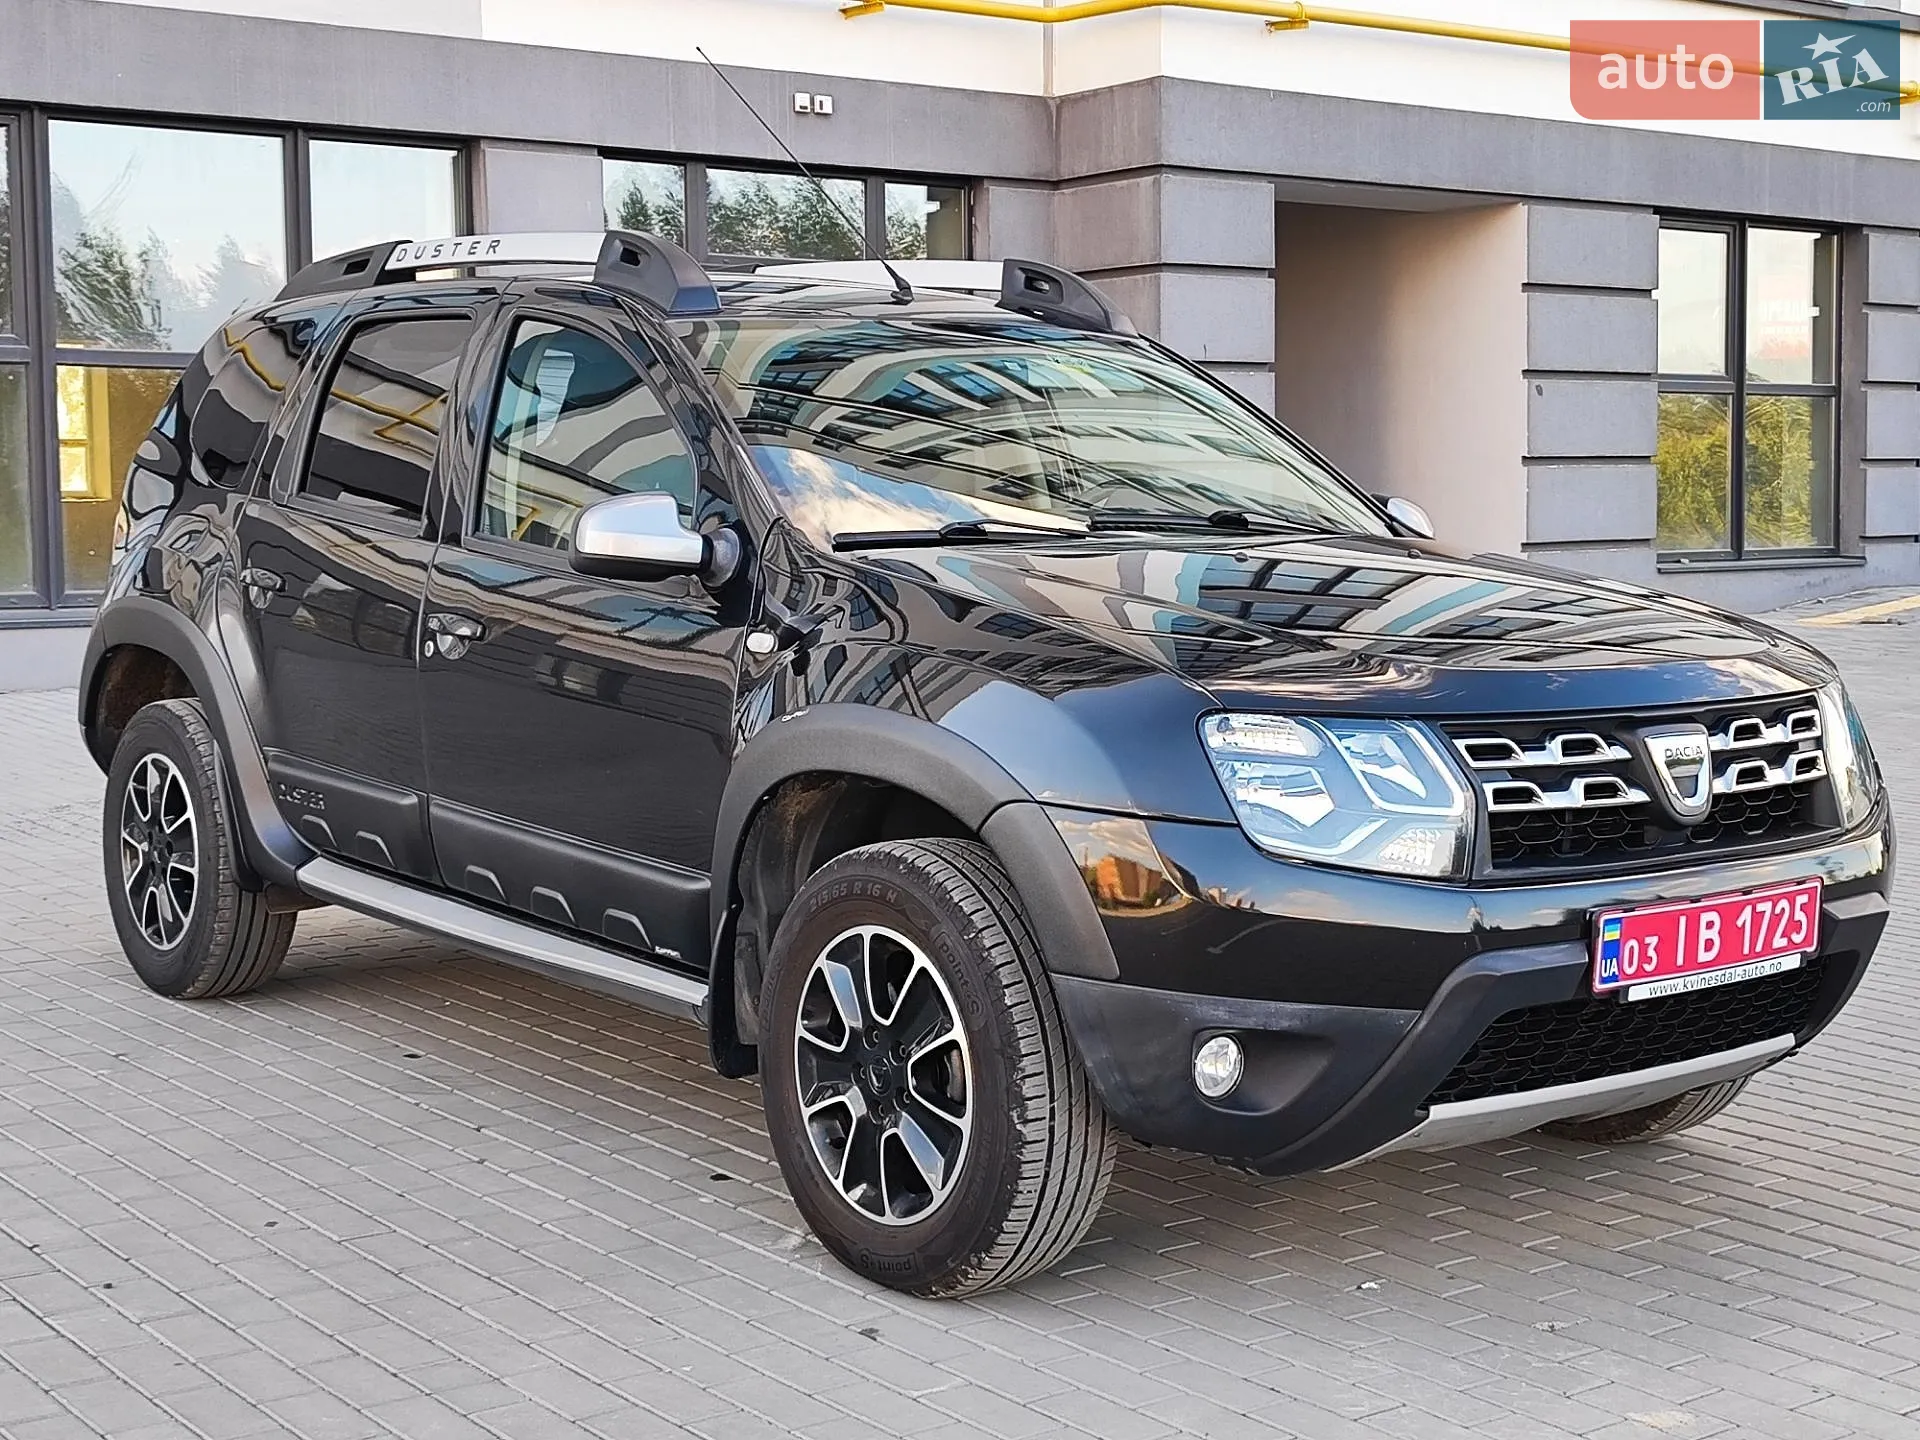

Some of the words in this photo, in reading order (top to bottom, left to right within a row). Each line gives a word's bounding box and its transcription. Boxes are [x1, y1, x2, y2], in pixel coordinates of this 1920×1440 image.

[396, 240, 501, 262] DUSTER
[1664, 745, 1703, 759] DACIA
[1622, 935, 1660, 976] 03
[1675, 910, 1722, 968] IB
[1735, 893, 1810, 956] 1725
[1601, 957, 1619, 978] UA
[1648, 959, 1783, 997] www.kvinesdal-auto.no
